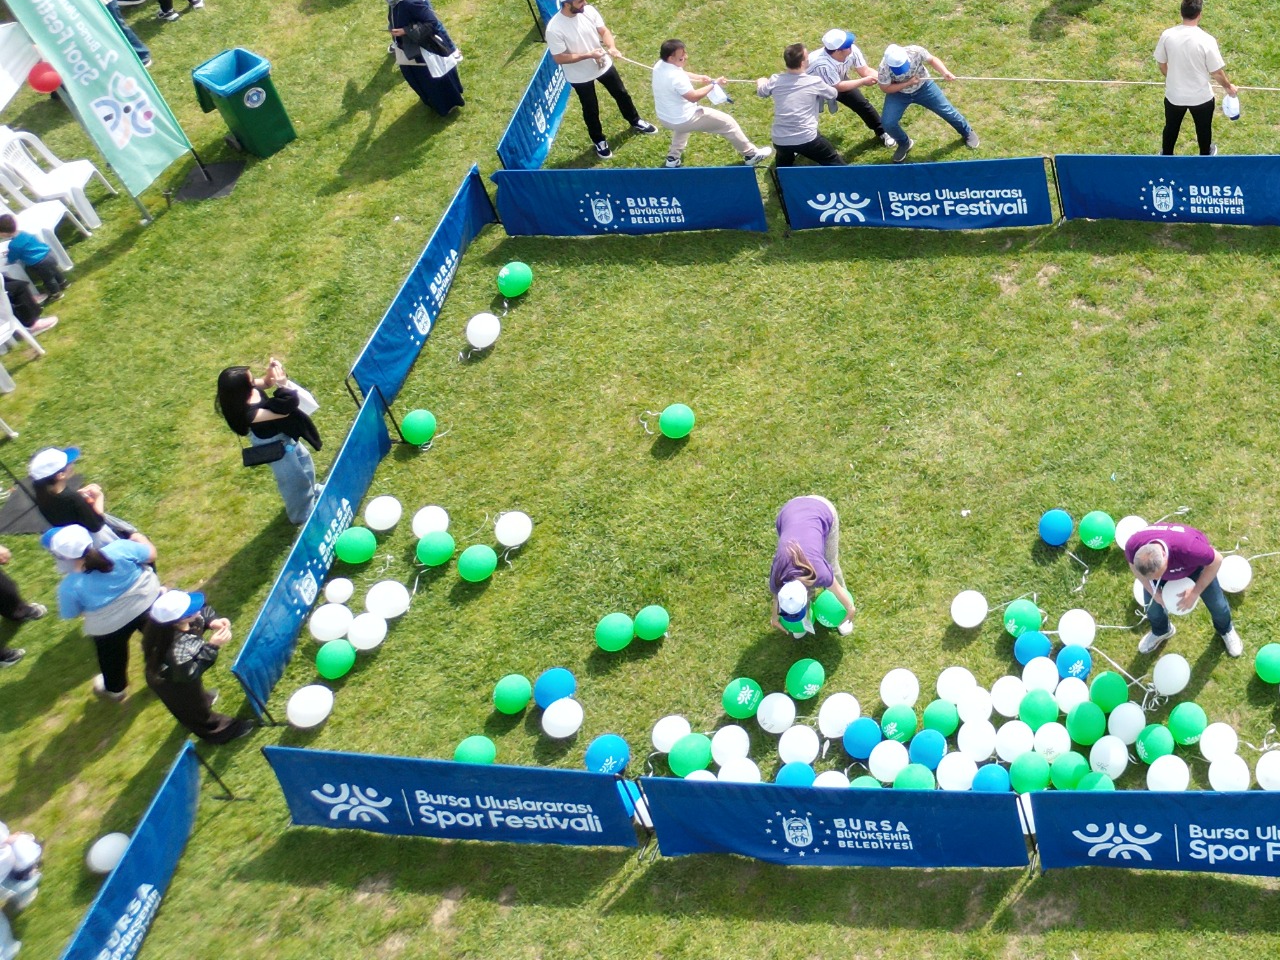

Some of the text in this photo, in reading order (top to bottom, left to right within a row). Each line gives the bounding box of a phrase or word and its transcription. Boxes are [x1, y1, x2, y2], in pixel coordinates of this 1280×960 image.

[888, 188, 1022, 202] Bursa Uluslararası
[1189, 185, 1244, 197] BURSA
[626, 196, 682, 207] BURSA
[890, 198, 1028, 221] Spor Festivali
[1190, 205, 1245, 215] BELEDİYESİ
[631, 213, 685, 224] BELEDİYESİ
[430, 248, 458, 295] BURSA
[319, 498, 350, 556] BURSA
[415, 790, 593, 814] Bursa Uluslararası
[419, 805, 603, 833] Spor Festivali
[833, 817, 910, 833] BURSA
[836, 829, 911, 841] BÜYÜKŞEHİR
[1189, 824, 1249, 840] Bursa
[838, 839, 914, 850] BELEDİYESİ
[1189, 840, 1261, 865] Spor
